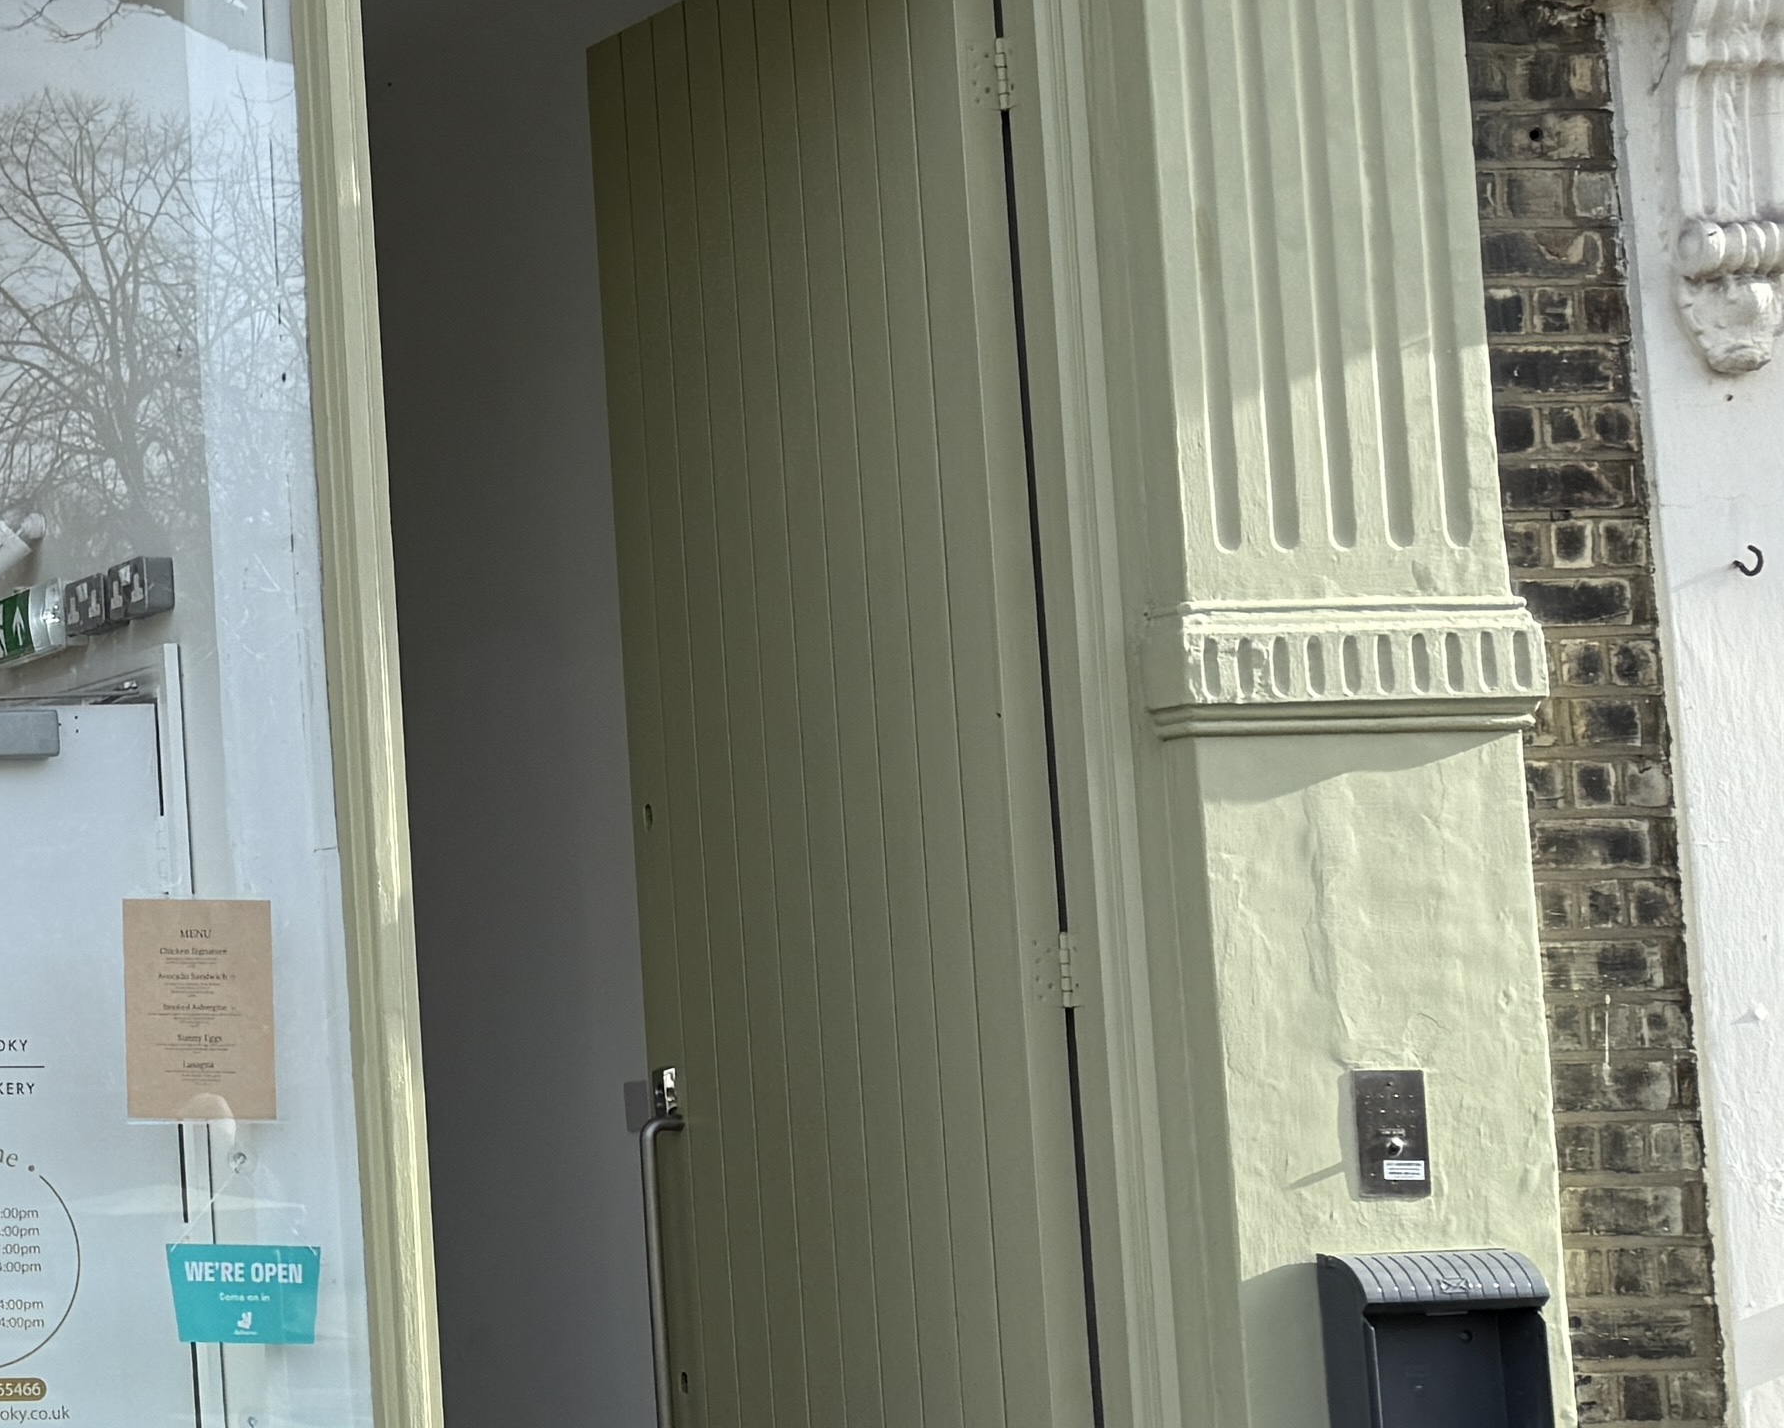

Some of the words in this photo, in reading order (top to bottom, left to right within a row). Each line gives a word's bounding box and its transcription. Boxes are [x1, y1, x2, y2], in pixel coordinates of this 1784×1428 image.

[179, 929, 212, 939] MENU
[184, 1260, 246, 1283] WE'RE
[250, 1262, 303, 1284] OPEN
[219, 1292, 245, 1302] Come
[247, 1294, 259, 1302] on
[261, 1292, 270, 1302] in
